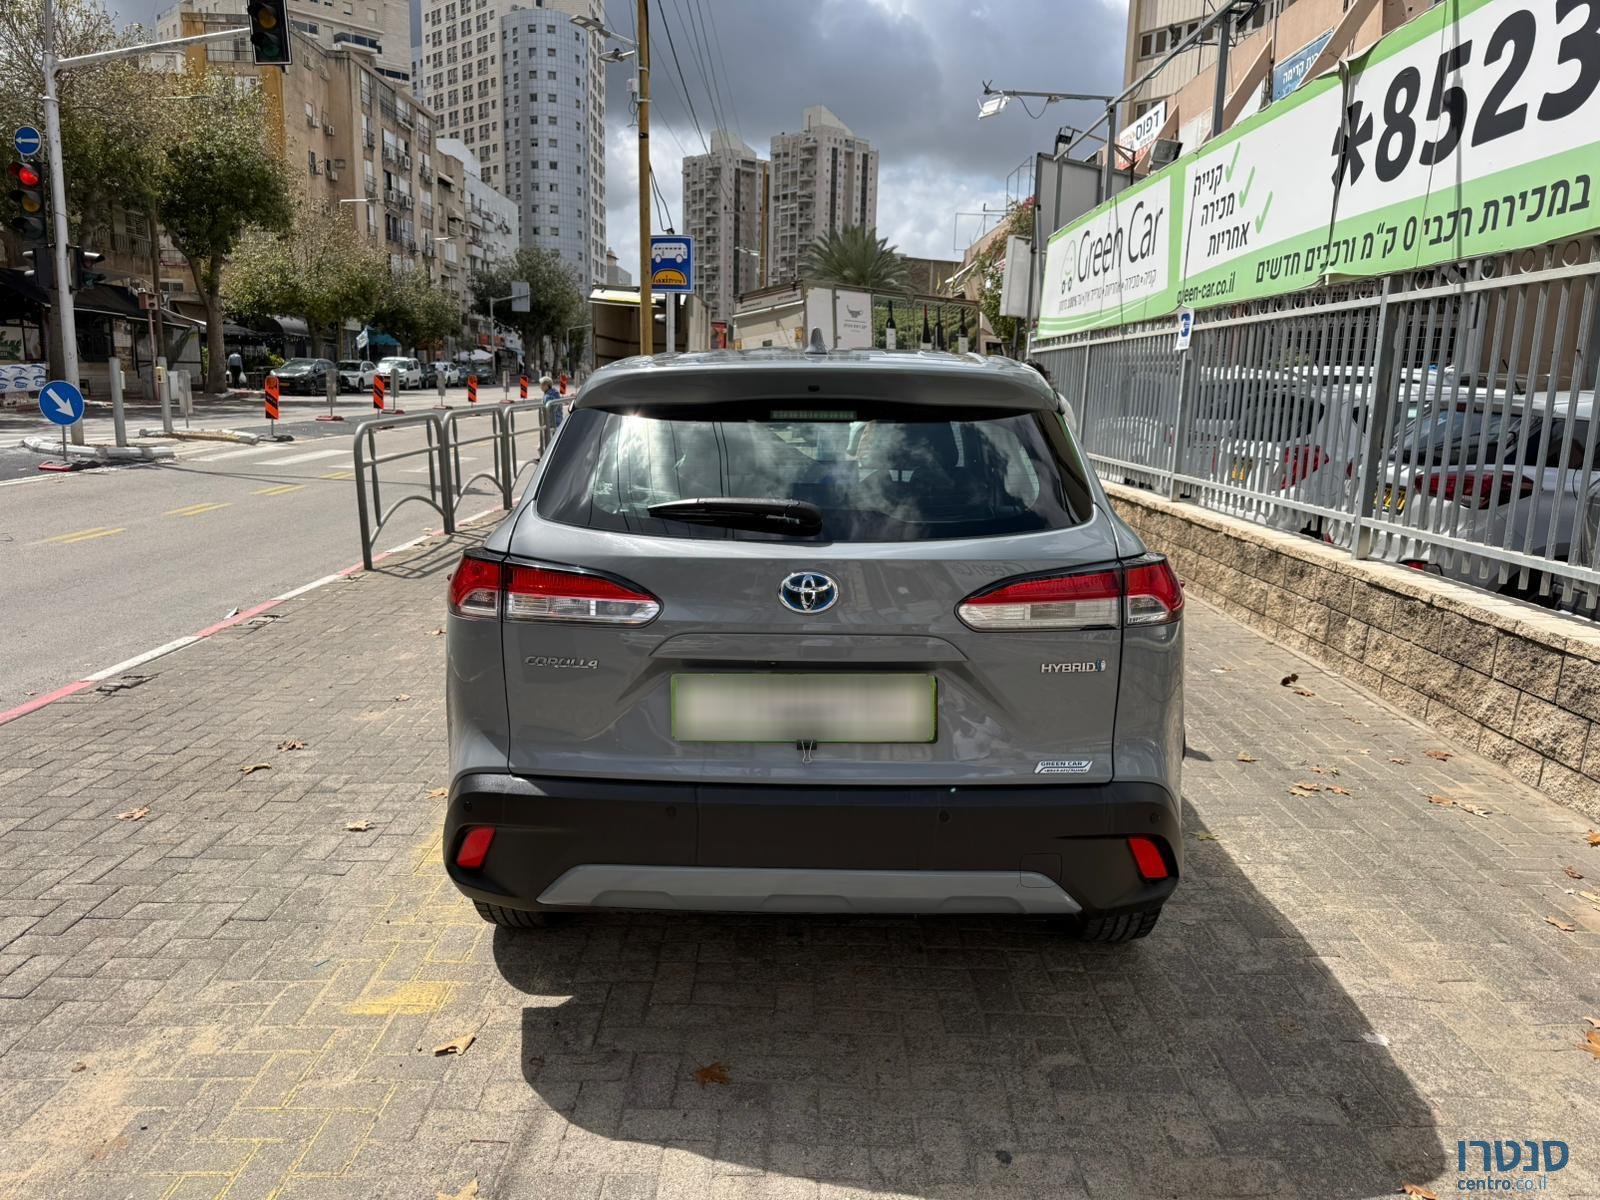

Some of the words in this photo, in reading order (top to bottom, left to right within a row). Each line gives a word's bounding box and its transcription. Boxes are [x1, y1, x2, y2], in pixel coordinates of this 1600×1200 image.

[1283, 61, 1305, 84] קדימה
[1136, 110, 1160, 141] דפוס
[1194, 164, 1223, 197] קנייה
[1201, 192, 1235, 227] מכירה
[1478, 174, 1591, 235] במכירת
[1078, 226, 1123, 283] Green
[1128, 200, 1164, 263] Car
[1207, 221, 1251, 257] אחריות
[1403, 215, 1417, 251] 0
[1424, 206, 1473, 246] רכבי
[1255, 251, 1301, 284] חדשים
[1304, 236, 1356, 272] ורכבים
[524, 656, 598, 669] COROLLA
[1041, 662, 1097, 673] HYBRID
